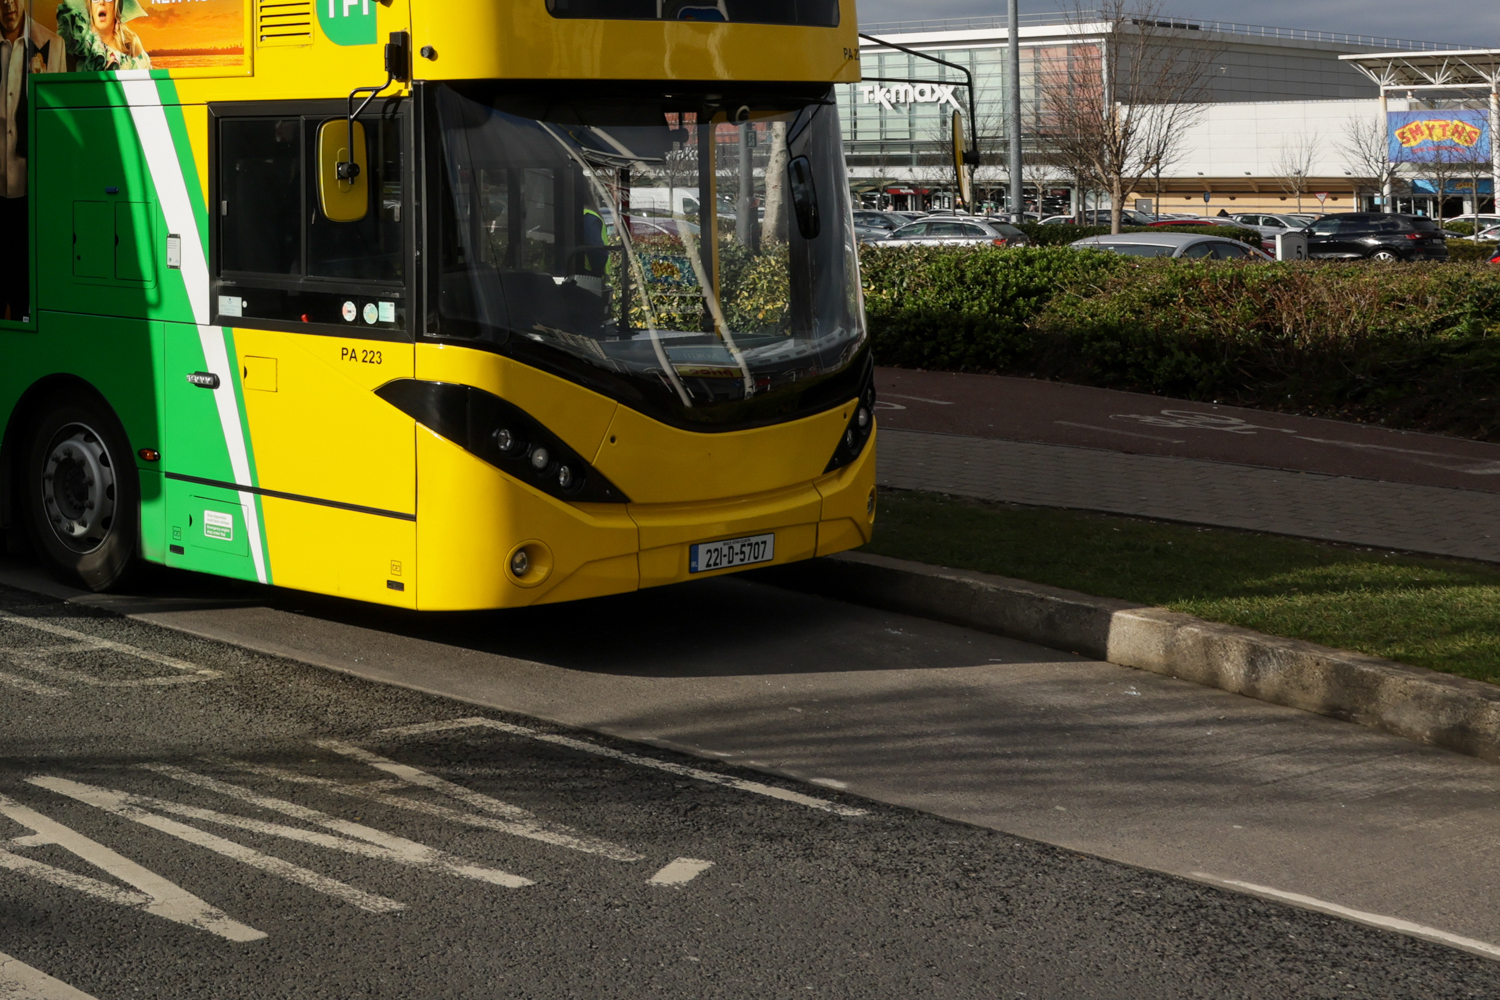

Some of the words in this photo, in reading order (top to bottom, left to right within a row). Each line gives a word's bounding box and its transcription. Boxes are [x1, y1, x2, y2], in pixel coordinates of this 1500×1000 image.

[1397, 122, 1479, 146] SMYTHS
[341, 347, 358, 364] PA
[361, 349, 383, 365] 223
[705, 540, 767, 569] 221-D-5707
